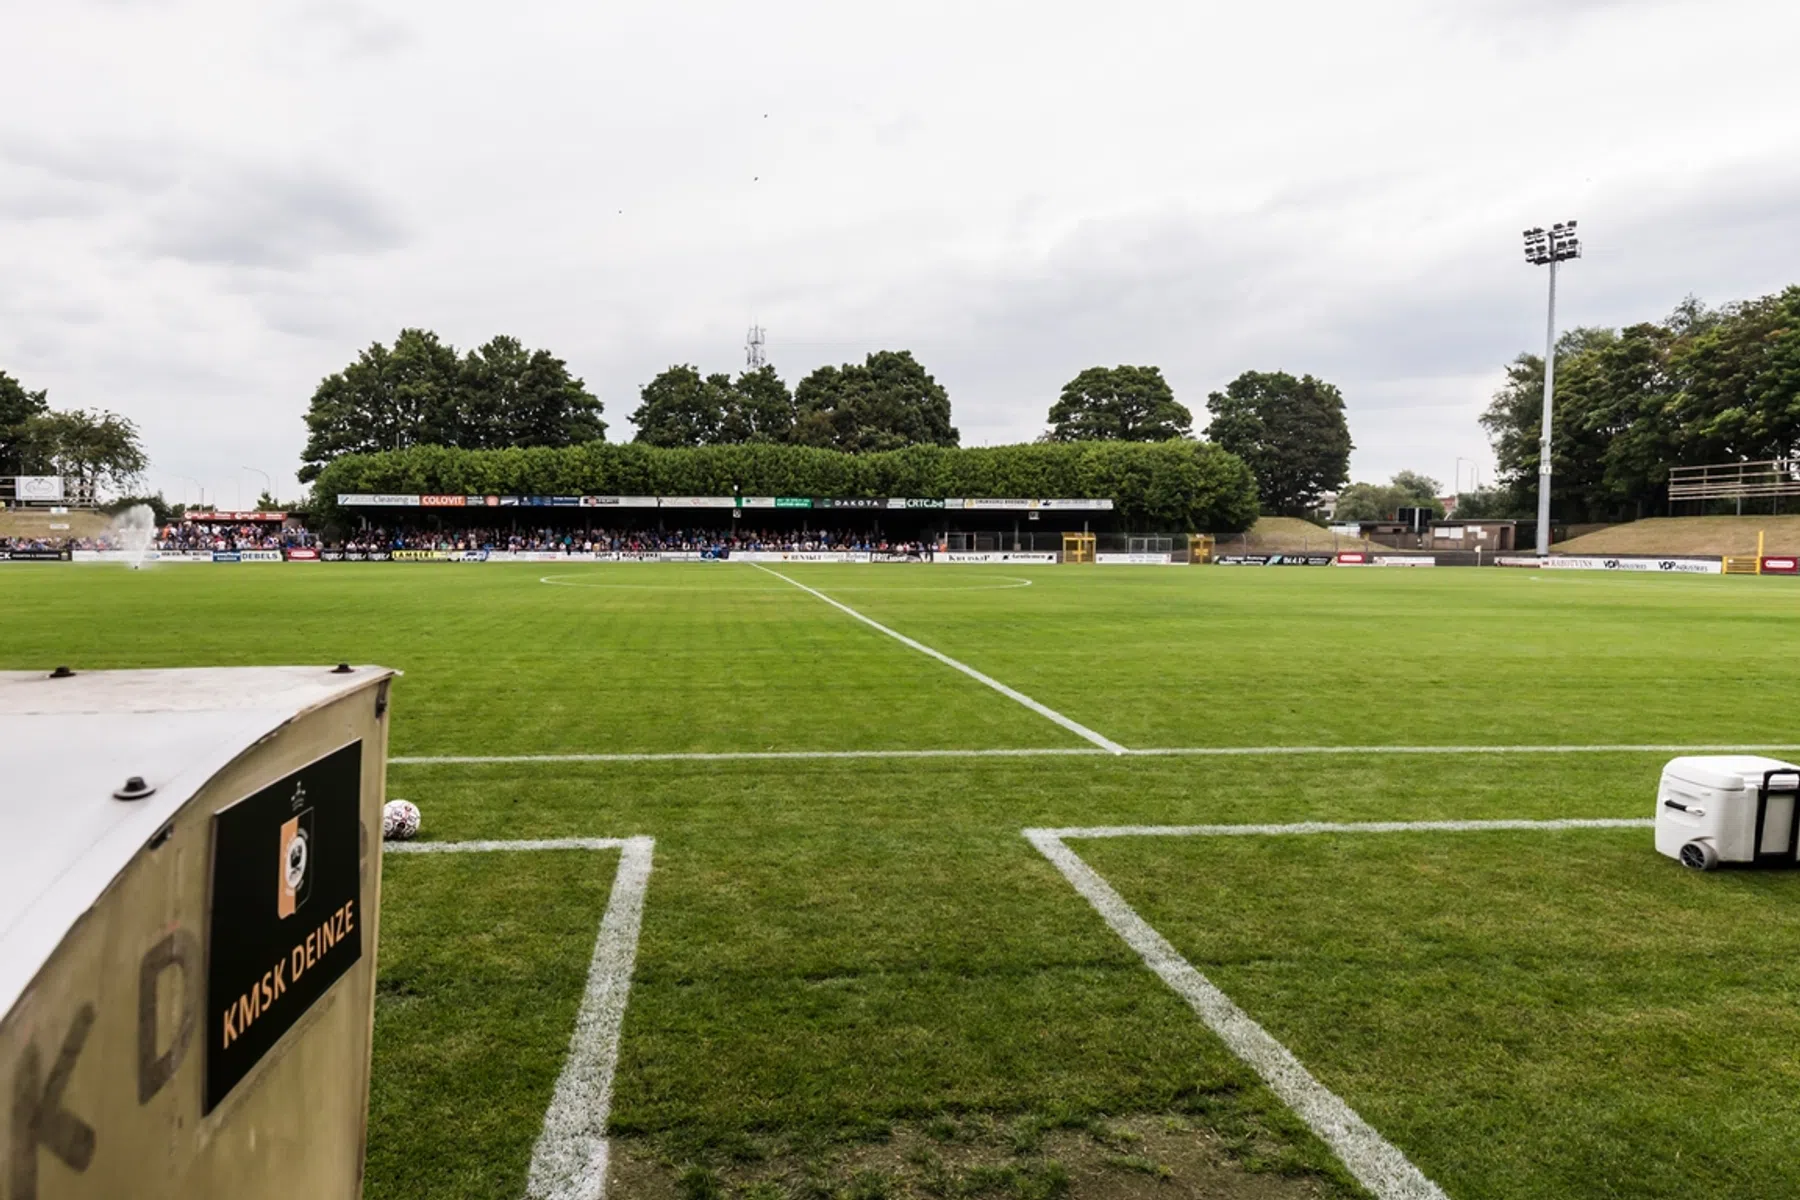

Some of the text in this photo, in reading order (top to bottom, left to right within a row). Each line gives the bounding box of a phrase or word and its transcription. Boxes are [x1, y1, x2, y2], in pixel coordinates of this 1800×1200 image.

[422, 496, 465, 505] COLOVIT
[906, 498, 944, 508] CRTC.be
[1658, 561, 1675, 570] VDP
[223, 900, 355, 1049] KMSK DEINZE
